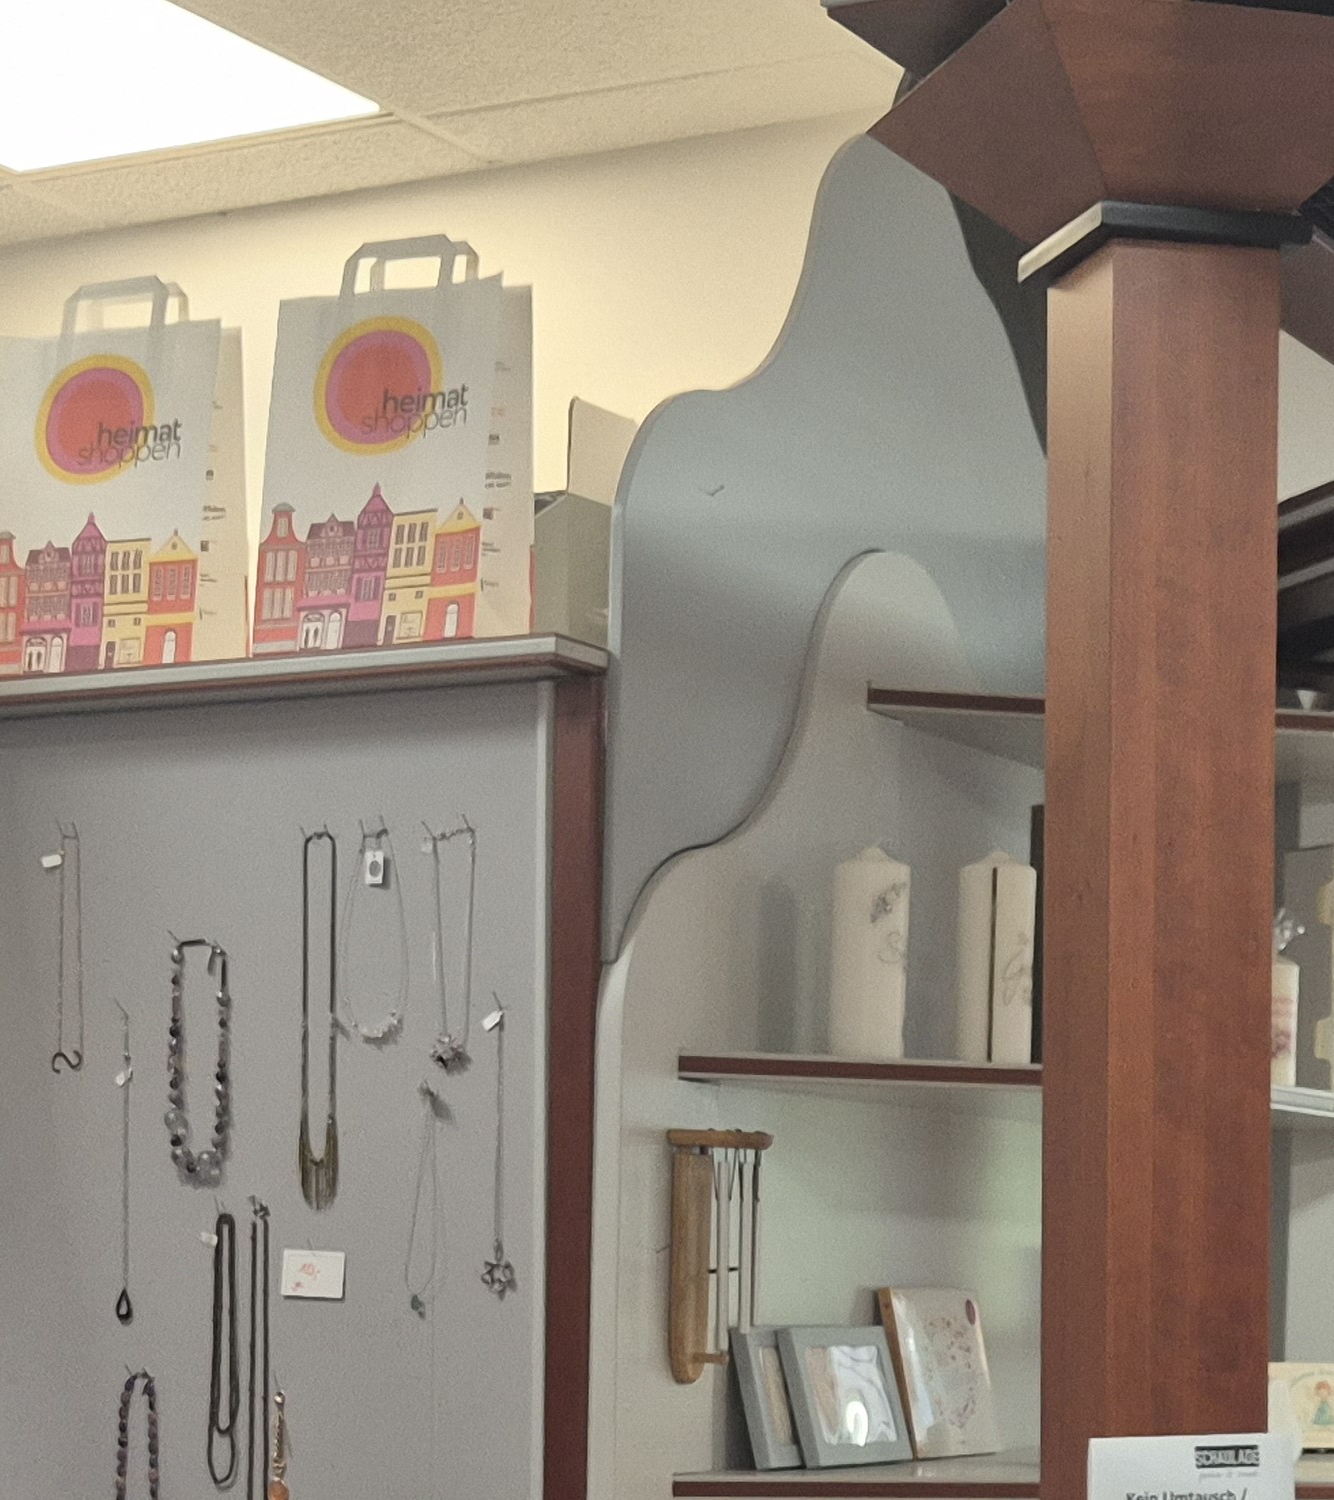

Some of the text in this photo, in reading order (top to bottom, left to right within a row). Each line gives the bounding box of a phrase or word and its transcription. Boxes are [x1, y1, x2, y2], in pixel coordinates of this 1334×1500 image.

[383, 384, 469, 414] heimat
[97, 418, 182, 446] heimat
[361, 406, 467, 439] shoppen
[78, 441, 180, 468] shoppen
